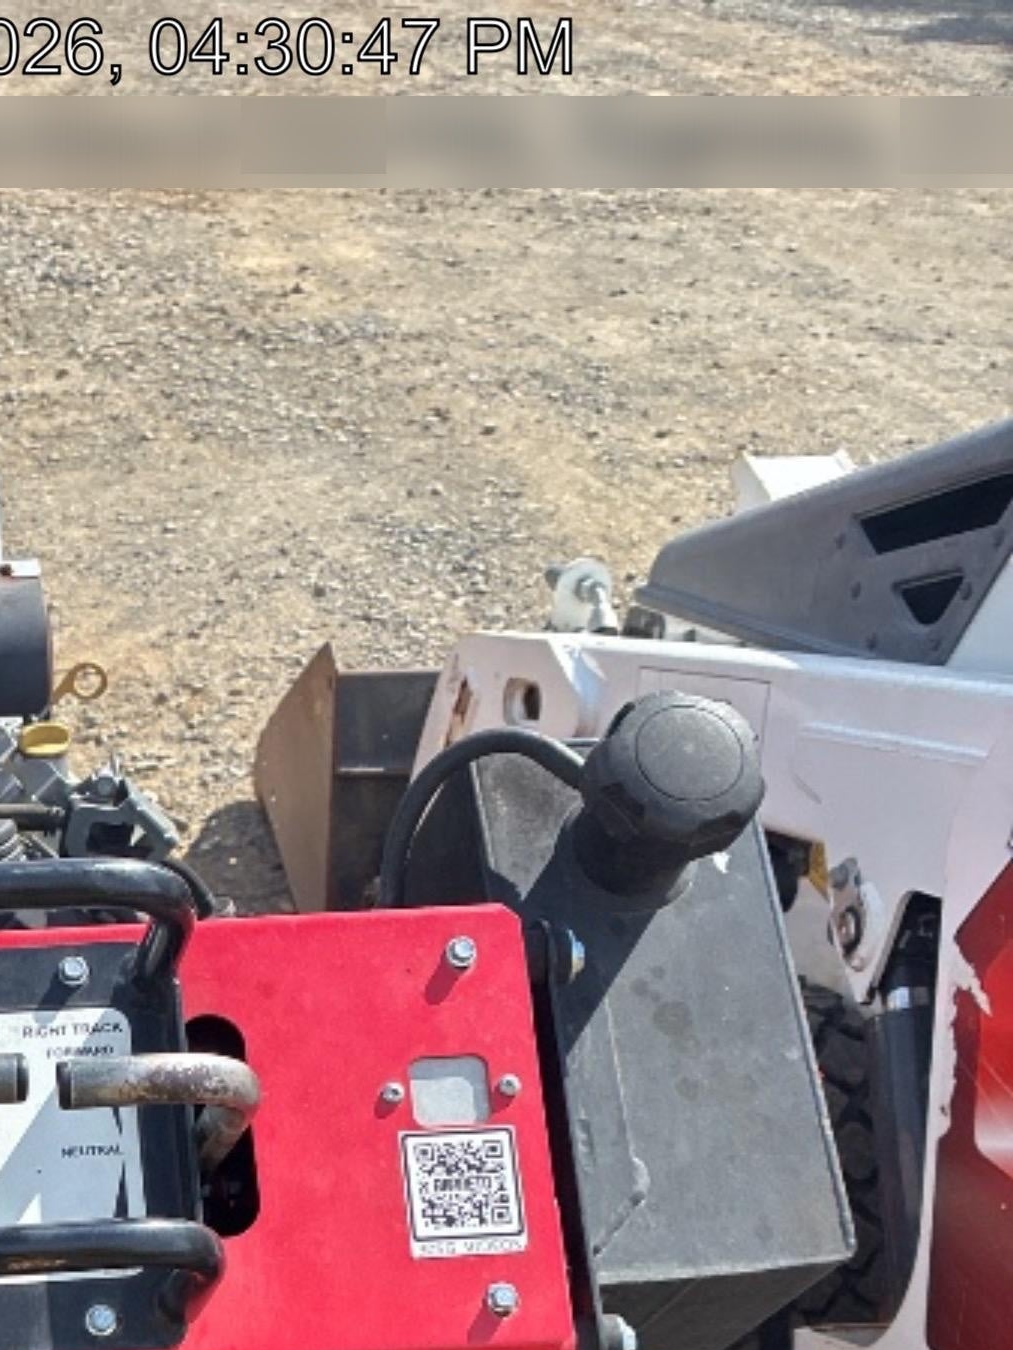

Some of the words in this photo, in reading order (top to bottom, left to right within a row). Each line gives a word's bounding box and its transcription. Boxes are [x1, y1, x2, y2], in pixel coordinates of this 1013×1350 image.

[22, 1024, 67, 1039] RIGHT
[72, 1021, 124, 1035] TRACK
[61, 1143, 126, 1159] NEUTRAL
